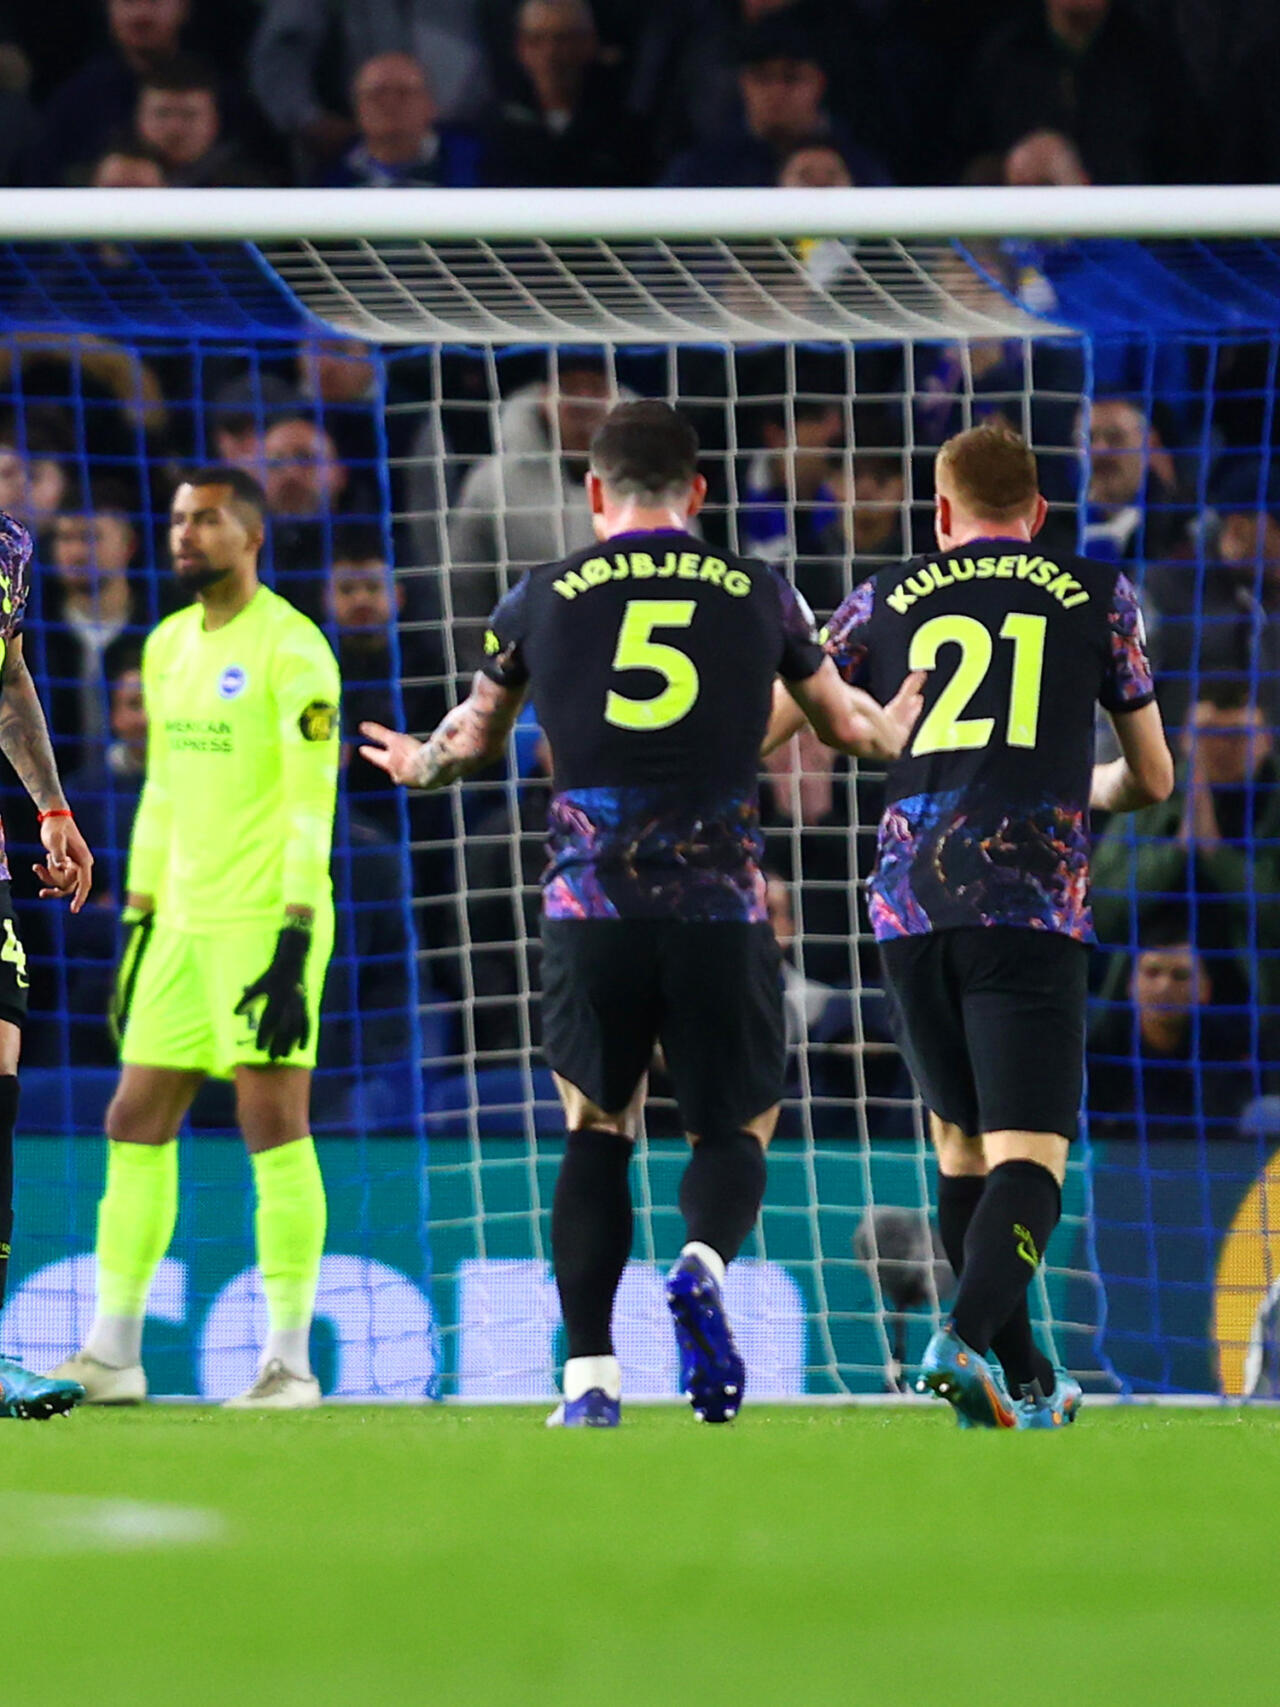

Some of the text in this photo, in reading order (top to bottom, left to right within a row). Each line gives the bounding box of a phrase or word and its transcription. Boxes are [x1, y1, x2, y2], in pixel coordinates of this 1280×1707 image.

[552, 552, 752, 600] HØJBJERG
[886, 554, 1090, 615] KULUSEVSKI
[604, 599, 699, 731] 5
[908, 612, 1047, 758] 21
[0, 918, 27, 976] 4
